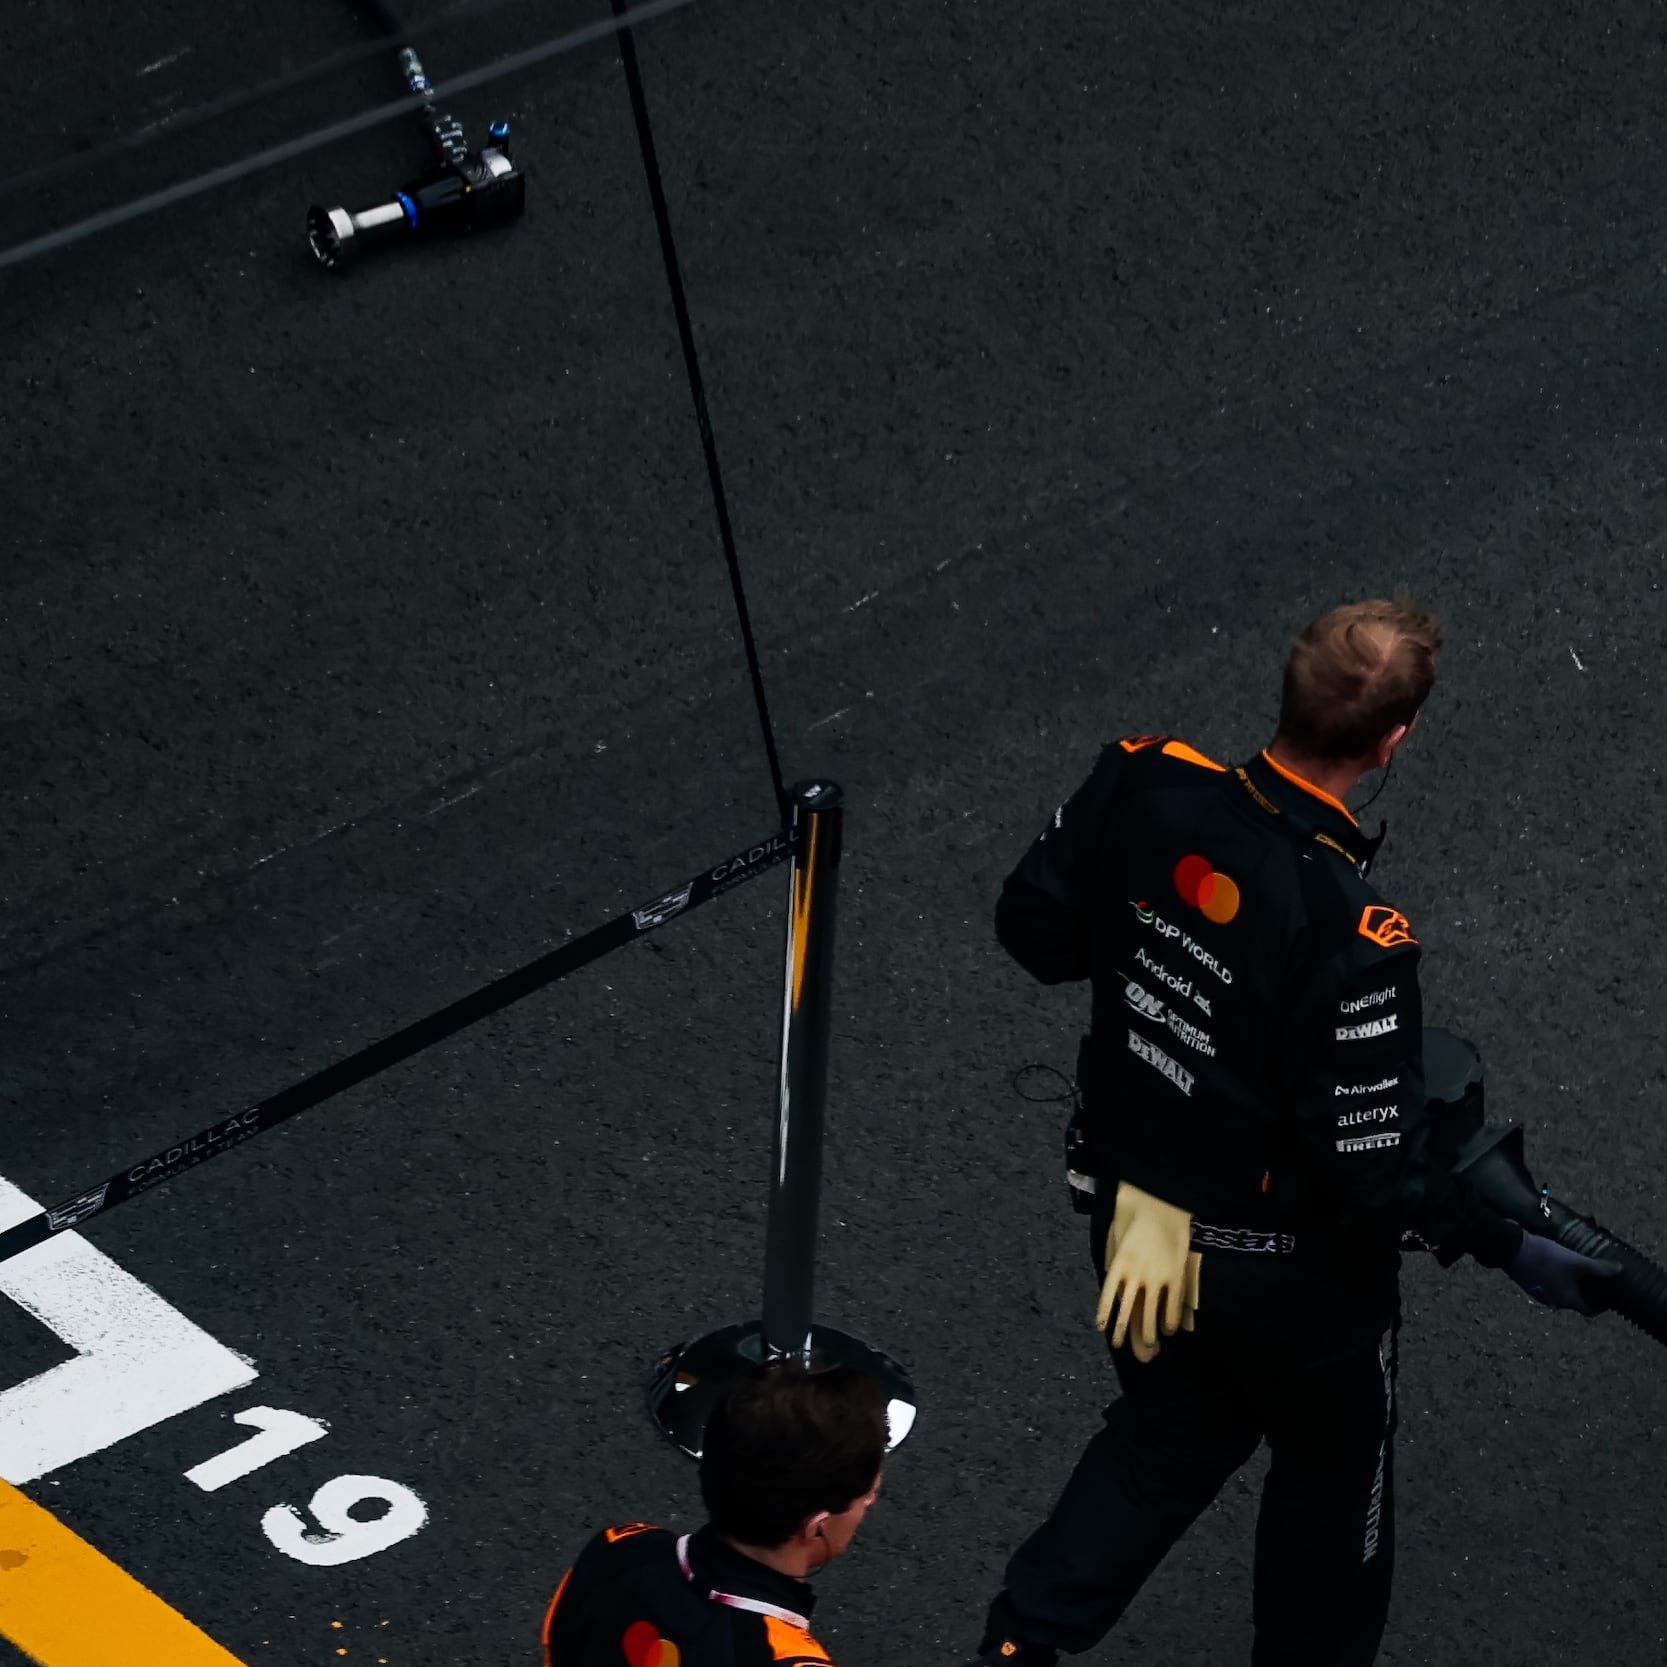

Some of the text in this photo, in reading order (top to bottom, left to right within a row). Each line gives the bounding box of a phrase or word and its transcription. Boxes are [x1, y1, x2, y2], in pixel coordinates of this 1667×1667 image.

[712, 830, 799, 881] CADILL
[1134, 948, 1192, 997] Android
[1155, 917, 1233, 984] DP WORLD
[128, 1108, 260, 1182] CADILLAC
[1337, 1104, 1399, 1129] alteryx
[183, 1405, 429, 1566] 19
